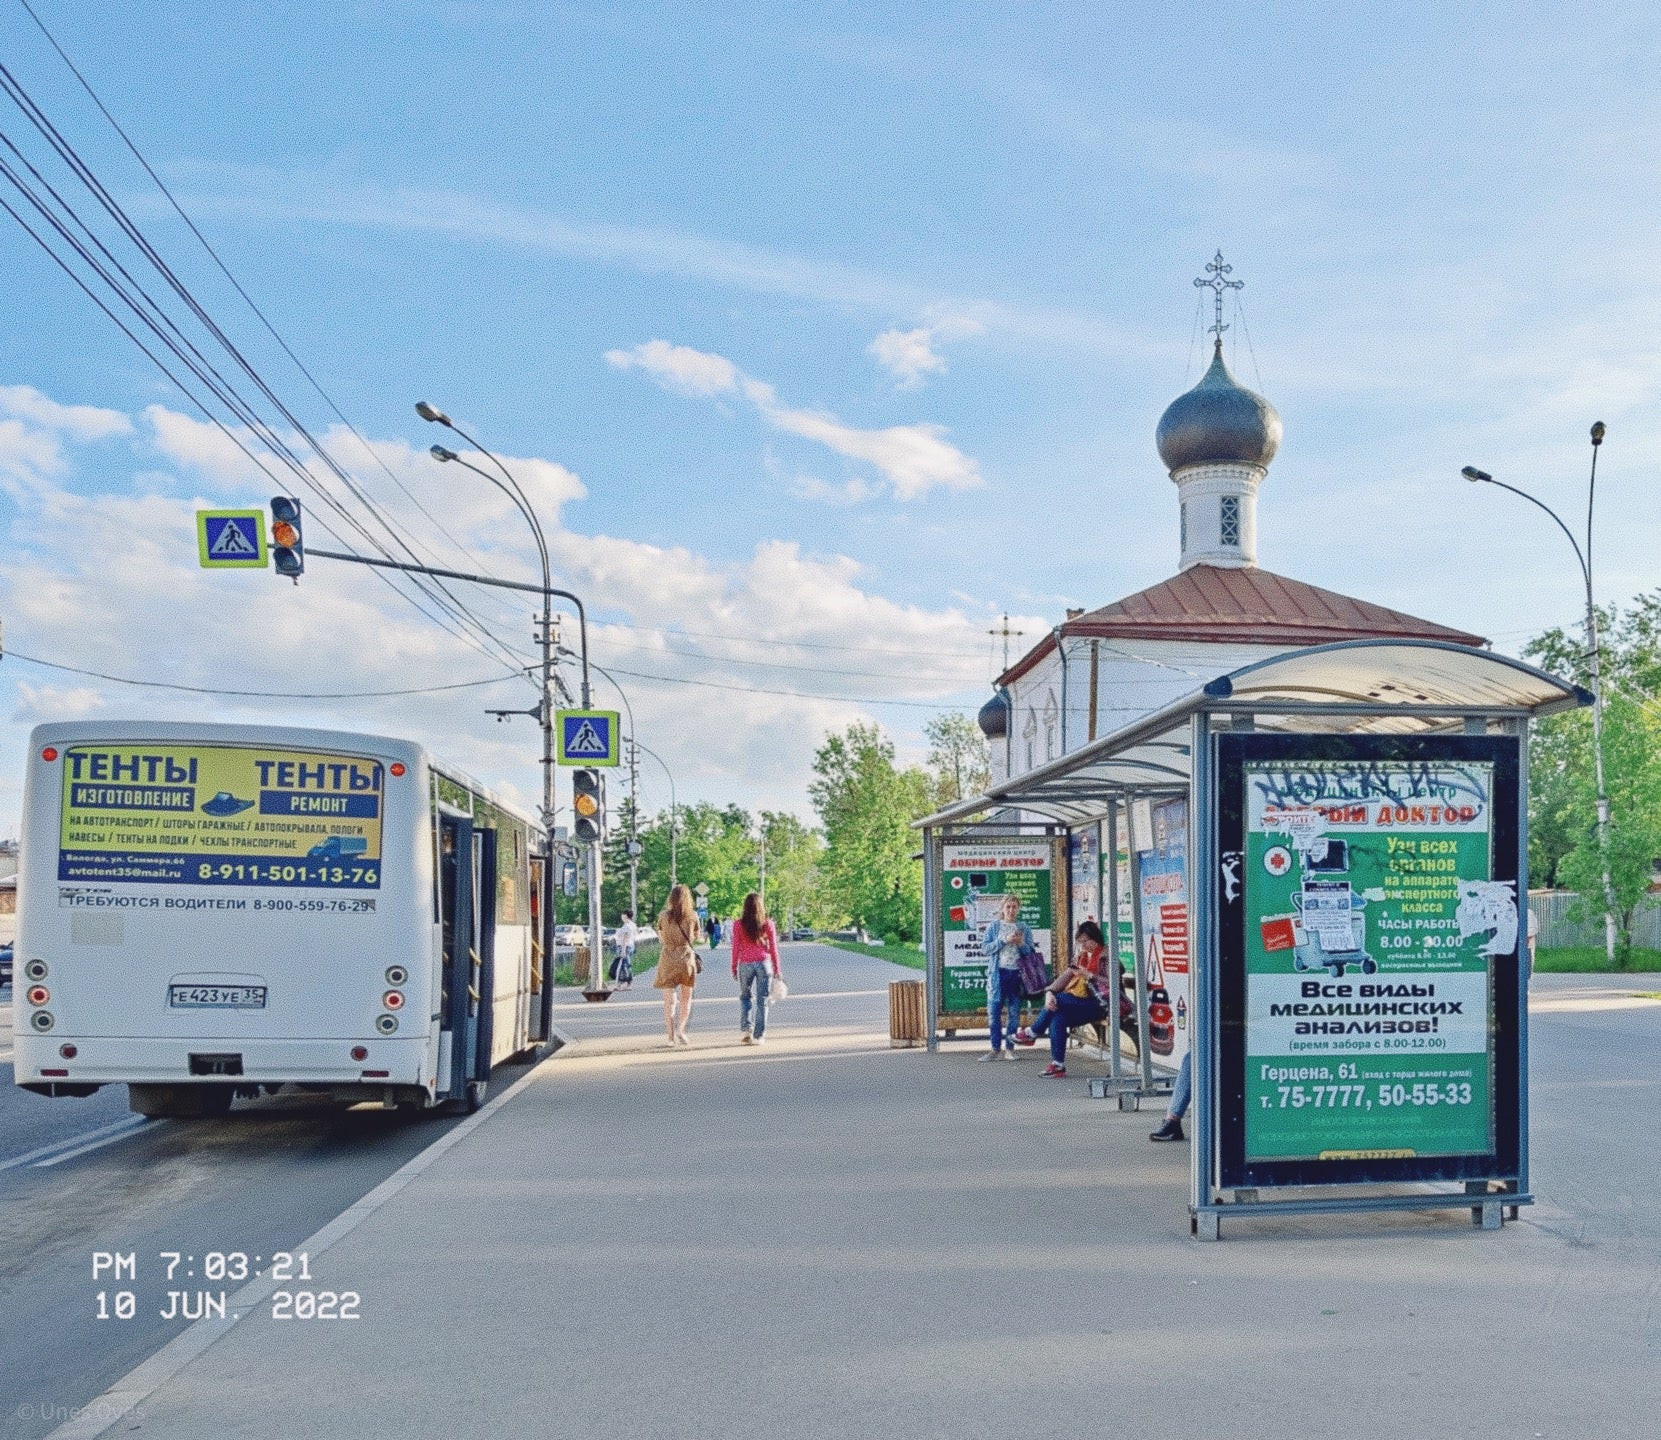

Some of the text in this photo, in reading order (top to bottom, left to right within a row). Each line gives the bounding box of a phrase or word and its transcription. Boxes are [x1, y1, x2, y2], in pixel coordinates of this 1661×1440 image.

[65, 752, 197, 783] ТЕНТЫ
[255, 760, 381, 791] ТЕНТЫ
[77, 788, 190, 807] ИЗГОТОВЛЕНИЕ
[290, 797, 348, 812] РЕМОНТ
[1376, 805, 1476, 826] ДОКТОР
[70, 817, 82, 826] НА
[83, 817, 154, 828] АВТОТРАНСПОРТ
[163, 819, 196, 829] ШТОРЫ
[198, 819, 244, 831] ГАРАЖНЫЕ
[331, 825, 363, 835] ПОЛОГИ
[69, 832, 105, 842] НАВЕСЫ
[116, 833, 144, 844] ТЕНТЫ
[146, 835, 157, 844] НА
[160, 835, 188, 845] ЛОДКИ
[200, 835, 229, 846] ЧЕХЛЫ
[232, 837, 297, 849] ТРАНСПОРТНЫЕ
[1387, 836, 1457, 854] Узи всех
[950, 857, 1045, 868] ДОБРЫЙ ДОКТОР
[68, 868, 181, 878] avtotent35@mail.ru
[199, 864, 377, 884] 8-911-501-13-76
[1384, 876, 1460, 888] на аппарате
[69, 896, 369, 912] ТРЕБУЮТСЯ ВОДИТЕЛИ 8-900-559-76-29
[1402, 903, 1443, 913] класса
[1378, 920, 1412, 929] ЧАСЫ
[1380, 936, 1411, 948] 8.00
[1301, 981, 1435, 998] Все виды
[1270, 1001, 1463, 1017] медицинских
[1295, 1017, 1438, 1035] анализов!
[1289, 1038, 1446, 1051] (время забора с 8.00-12.00)
[1261, 1064, 1334, 1084] Герцена,
[1338, 1063, 1358, 1079] 61
[1260, 1083, 1472, 1111] т. 75-7777, 50-55-33
